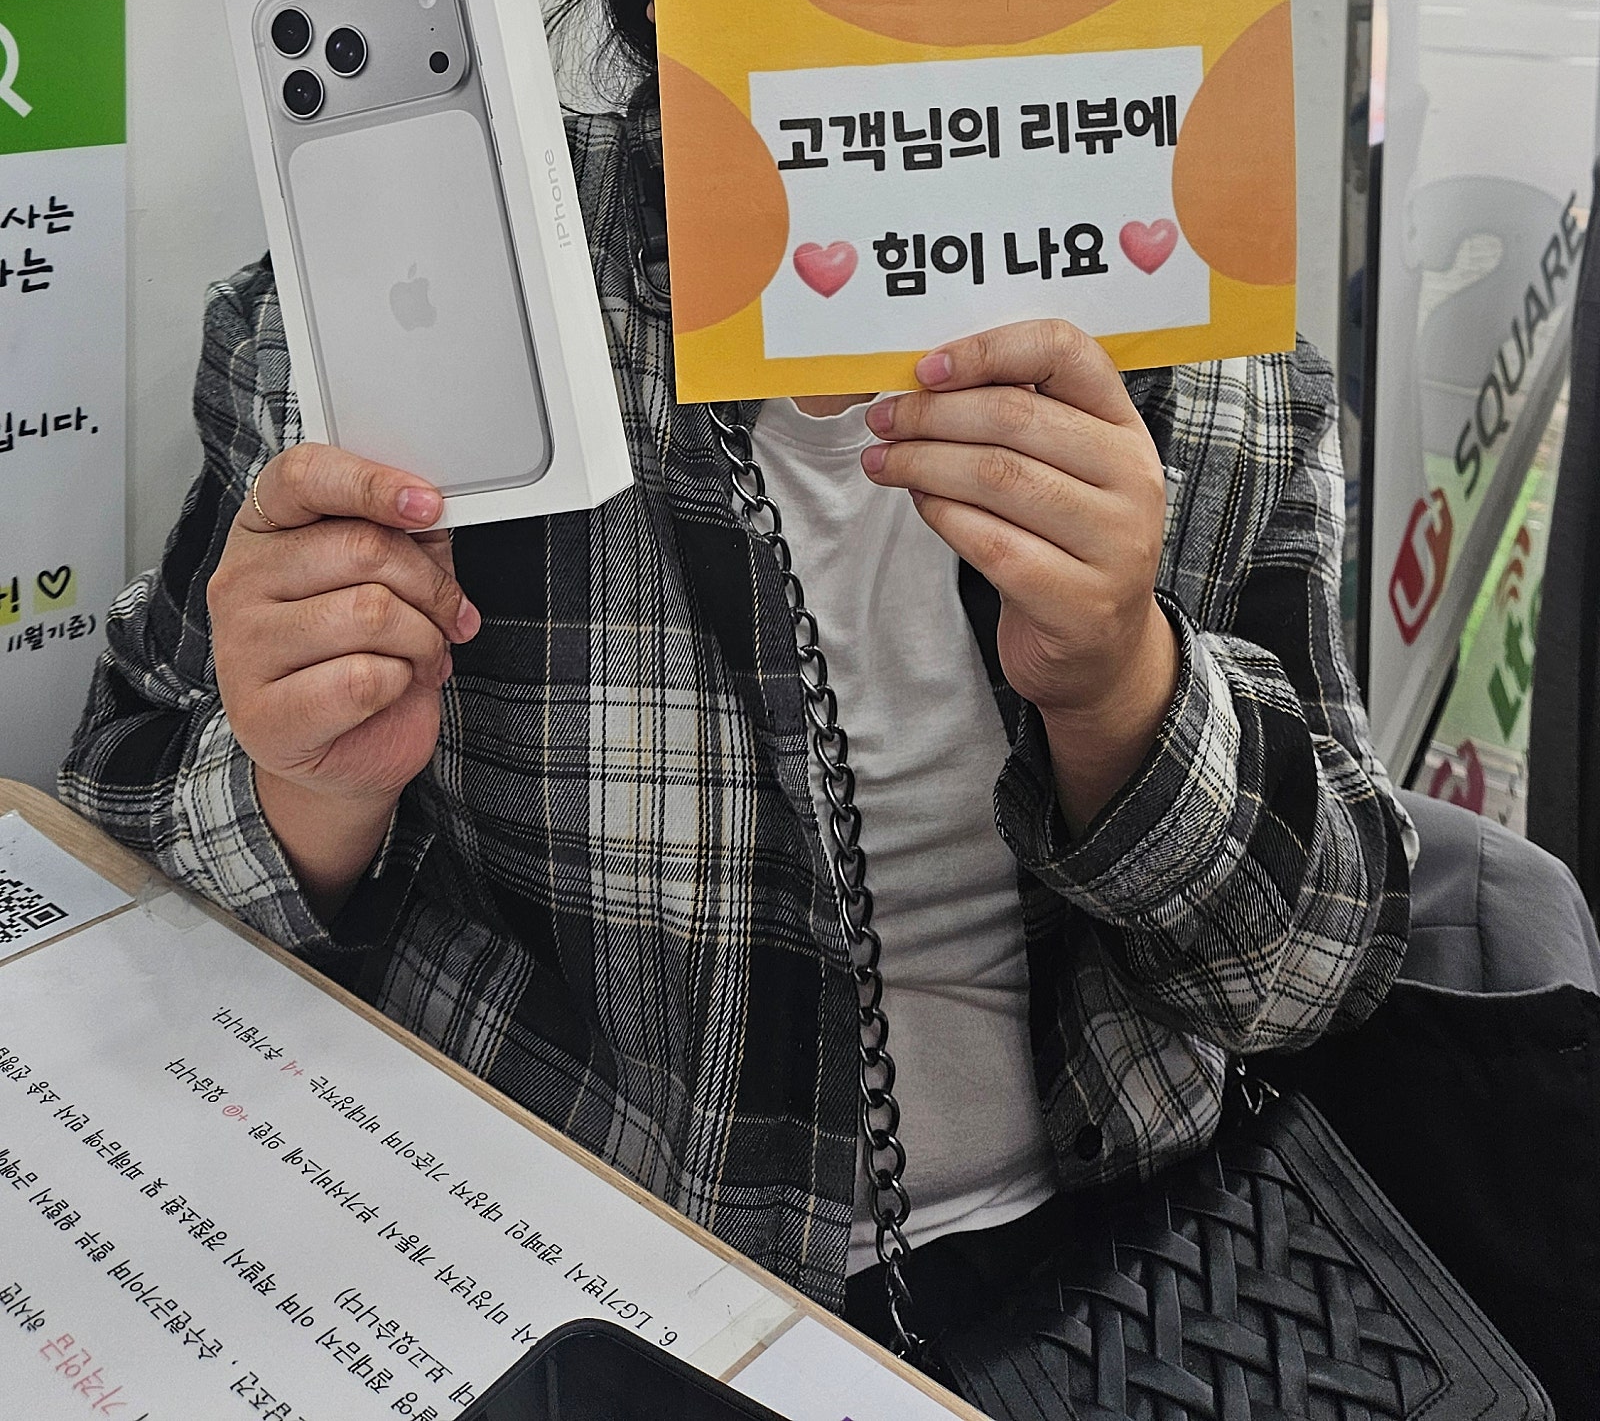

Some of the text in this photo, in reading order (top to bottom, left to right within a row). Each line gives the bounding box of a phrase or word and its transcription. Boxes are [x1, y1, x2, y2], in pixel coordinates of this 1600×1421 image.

[776, 94, 1179, 172] 고객님의 리뷰에
[544, 147, 573, 251] iPhone
[872, 222, 1109, 298] 힘이 나요
[1452, 189, 1587, 502] SQUARE
[210, 1005, 284, 1061] 추가됩니다.
[25, 1080, 61, 1104] 소송
[163, 1056, 229, 1103] 있습니다
[308, 1074, 381, 1134] 비대상자는
[52, 1103, 90, 1133] 민사
[246, 1120, 286, 1150] 의한
[80, 1128, 145, 1181] 피해금액
[379, 1129, 450, 1182] 기준이며
[27, 1186, 82, 1231] 원할시
[138, 1176, 169, 1199] 및
[280, 1146, 380, 1224] 부가서비스에
[447, 1179, 504, 1223] 대상자
[73, 1230, 116, 1263] 할부
[159, 1193, 228, 1252] 경찰소환
[376, 1219, 436, 1267] 개통시
[503, 1218, 563, 1266] 캠페인
[221, 1247, 277, 1297] 적발시
[432, 1263, 509, 1325] 미성년자
[562, 1261, 653, 1329] LG기변시
[105, 1258, 224, 1360] 순수현금가이며
[274, 1292, 315, 1328] 이며
[332, 1286, 453, 1384] 보고있습니다)
[0, 1281, 127, 1415] 가격언급 하시면
[313, 1325, 394, 1395] 절대금지
[659, 1324, 679, 1348] 6.
[228, 1370, 304, 1420] 납조건
